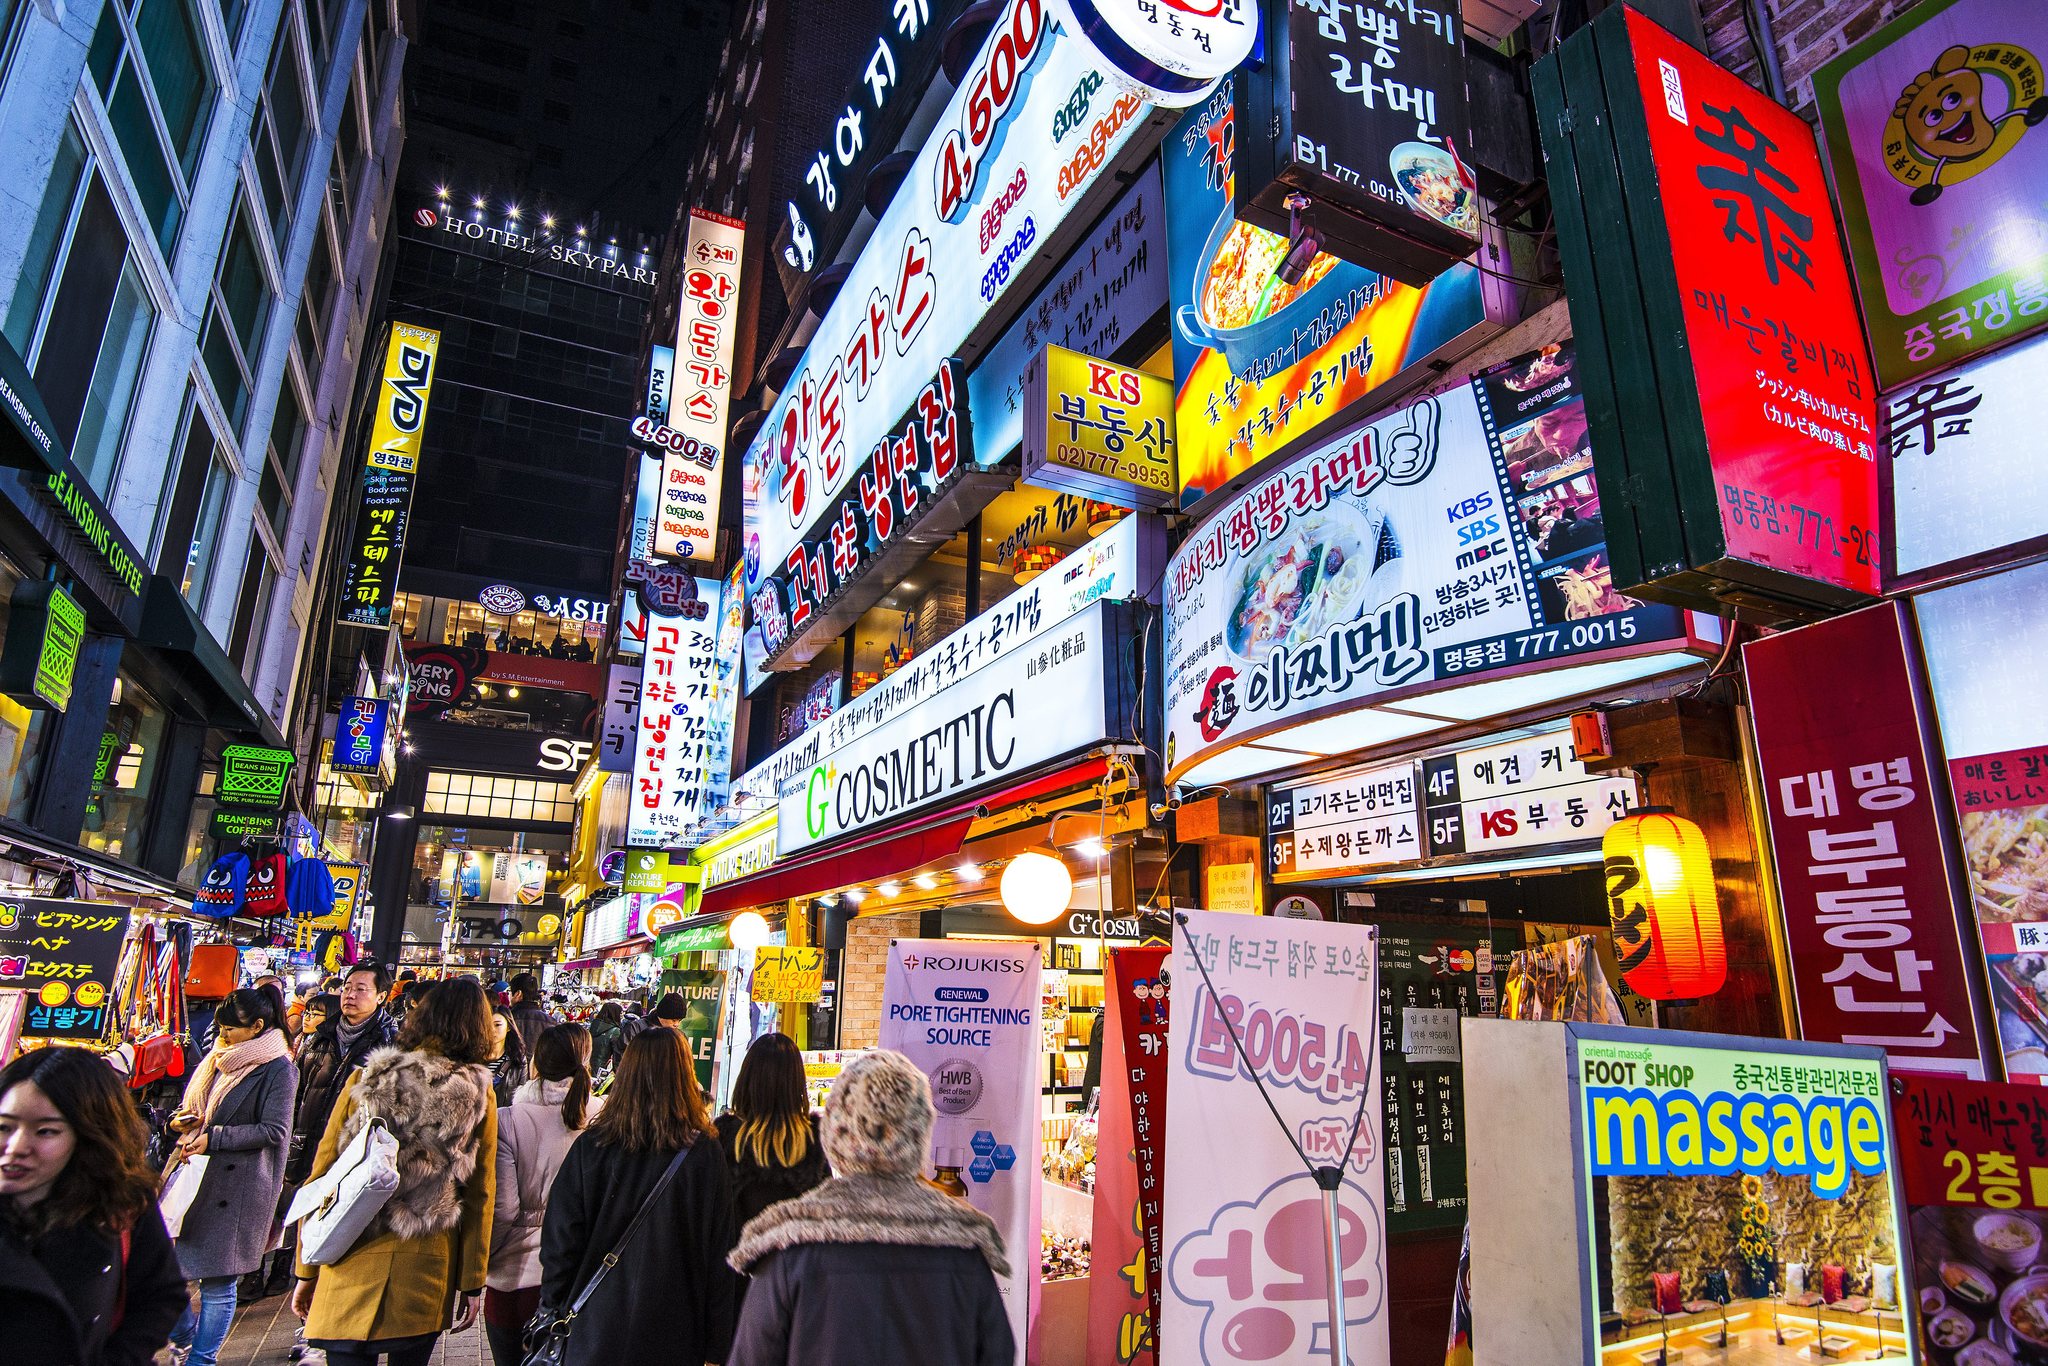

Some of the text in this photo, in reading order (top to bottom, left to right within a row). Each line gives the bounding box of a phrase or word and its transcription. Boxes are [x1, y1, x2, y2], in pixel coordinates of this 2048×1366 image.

[1138, 0, 1212, 54] 명동점
[1329, 53, 1443, 143] 라멘
[1297, 135, 1328, 172] B1
[442, 215, 535, 254] HOTEL
[696, 242, 734, 262] 수제
[687, 271, 733, 420] 왕돈가스
[1693, 288, 1862, 401] 매운갈비찜
[384, 341, 433, 433] DVD
[780, 243, 930, 517] 왕돈가스
[1088, 362, 1140, 406] KS
[0, 376, 53, 453] BEANSBINS COFFEE
[1053, 393, 1173, 465] 부동산
[632, 418, 717, 467] 4,500원
[861, 357, 959, 542] 냉면집
[373, 452, 414, 470] 영화관
[1057, 443, 1172, 489] 02)777-9953
[368, 486, 389, 494] Body
[370, 475, 389, 484] Skin
[1228, 433, 1382, 550] 짬뽕 라멘
[366, 497, 385, 505] Foot
[1447, 491, 1494, 524] KBS
[1456, 514, 1501, 547] SBS
[678, 543, 693, 556] 3F
[748, 538, 759, 570] 3F
[788, 502, 859, 628] 고기주는
[110, 541, 143, 598] COFFEE
[1435, 560, 1517, 606] 방송3사가
[487, 587, 520, 601] ASHLEY
[1422, 582, 1523, 635] 인정하는 곳!
[548, 597, 610, 624] ASH
[404, 658, 454, 681] VERY
[644, 625, 680, 702] 고기주는
[686, 630, 715, 702] 38번가
[1247, 597, 1422, 712] 이찌멘
[1443, 640, 1507, 673] 명동점
[491, 671, 565, 687] by S.M.Entertainment
[235, 762, 277, 773] BEANS BINS
[639, 712, 672, 809] 냉면집
[672, 716, 707, 813] 김치찌개
[836, 689, 1016, 831] COSMETIC
[1473, 754, 1522, 786] 애견
[1965, 760, 2006, 783] 매운
[1428, 769, 1455, 797] 4F
[1963, 782, 2046, 807] おいしい
[1271, 801, 1292, 826] 2F
[1433, 814, 1460, 845] 5F
[1482, 789, 1631, 840] KS 부동산
[1273, 839, 1293, 865] 3F
[627, 879, 665, 888] REPUBLIC
[630, 872, 663, 880] NATURE
[36, 911, 123, 932] ピアシング
[458, 917, 523, 940] PAO
[653, 914, 675, 923] TAX
[1807, 820, 1934, 1013] 부동산
[31, 935, 72, 951] ヘナ
[25, 961, 94, 980] エクステ
[923, 955, 1025, 974] ROJUKISS
[663, 985, 719, 1001] NATURE
[939, 988, 984, 1001] RENEWAL
[889, 1003, 1031, 1026] PORE TIGHTENING
[926, 1027, 992, 1048] SOURCE
[1584, 1046, 1653, 1062] oriental massage
[940, 1070, 972, 1086] HWB
[1584, 1059, 1695, 1088] FOOT SHOP
[1732, 1063, 1879, 1097] 중국전통발관리전문점
[938, 1087, 972, 1097] Best of Best
[942, 1096, 967, 1105] Product
[1592, 1095, 1882, 1192] massage
[1942, 1149, 2022, 1210] 2층
